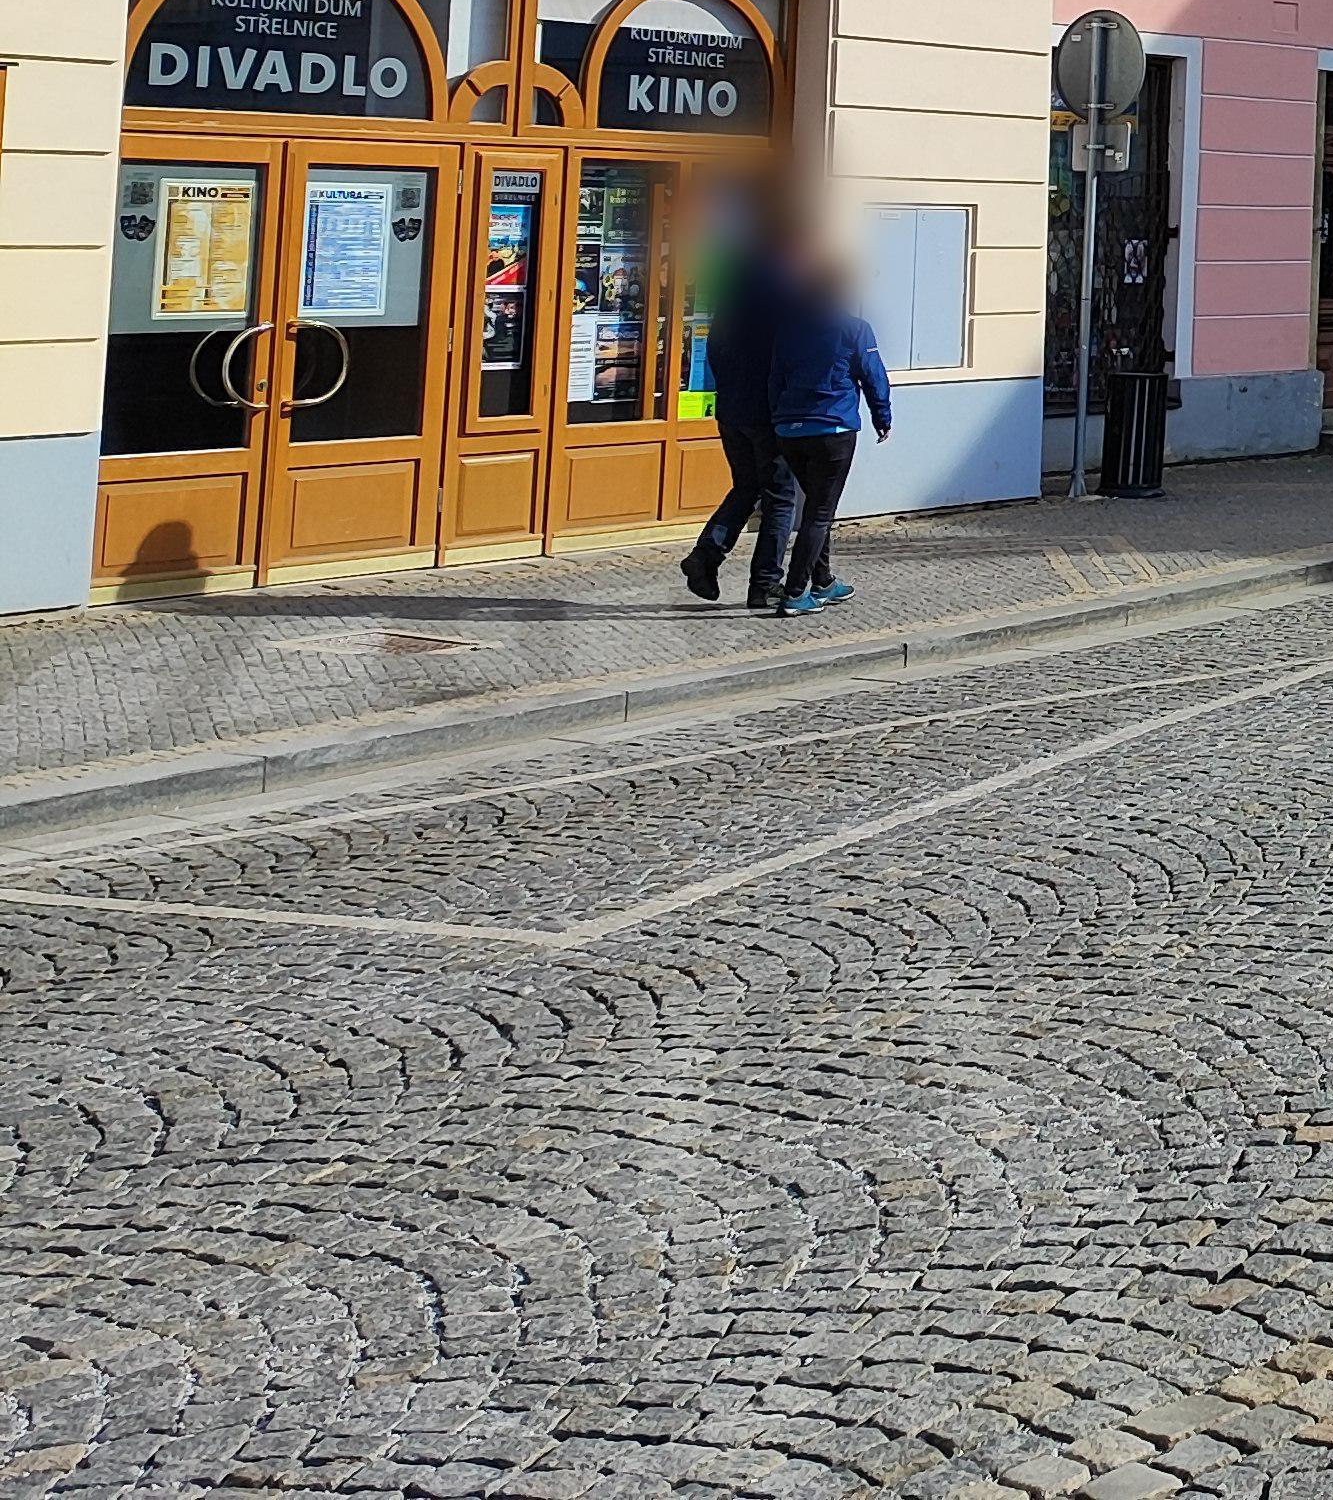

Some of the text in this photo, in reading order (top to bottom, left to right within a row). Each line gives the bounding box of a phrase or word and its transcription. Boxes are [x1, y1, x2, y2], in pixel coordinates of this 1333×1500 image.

[234, 12, 338, 39] STŘELNICE
[647, 45, 725, 69] STŘELNICE
[147, 42, 408, 99] DIVADLO
[628, 74, 738, 118] KINO
[181, 186, 220, 198] KINO
[493, 175, 538, 188] DIVADLO
[318, 190, 364, 200] KULTURA
